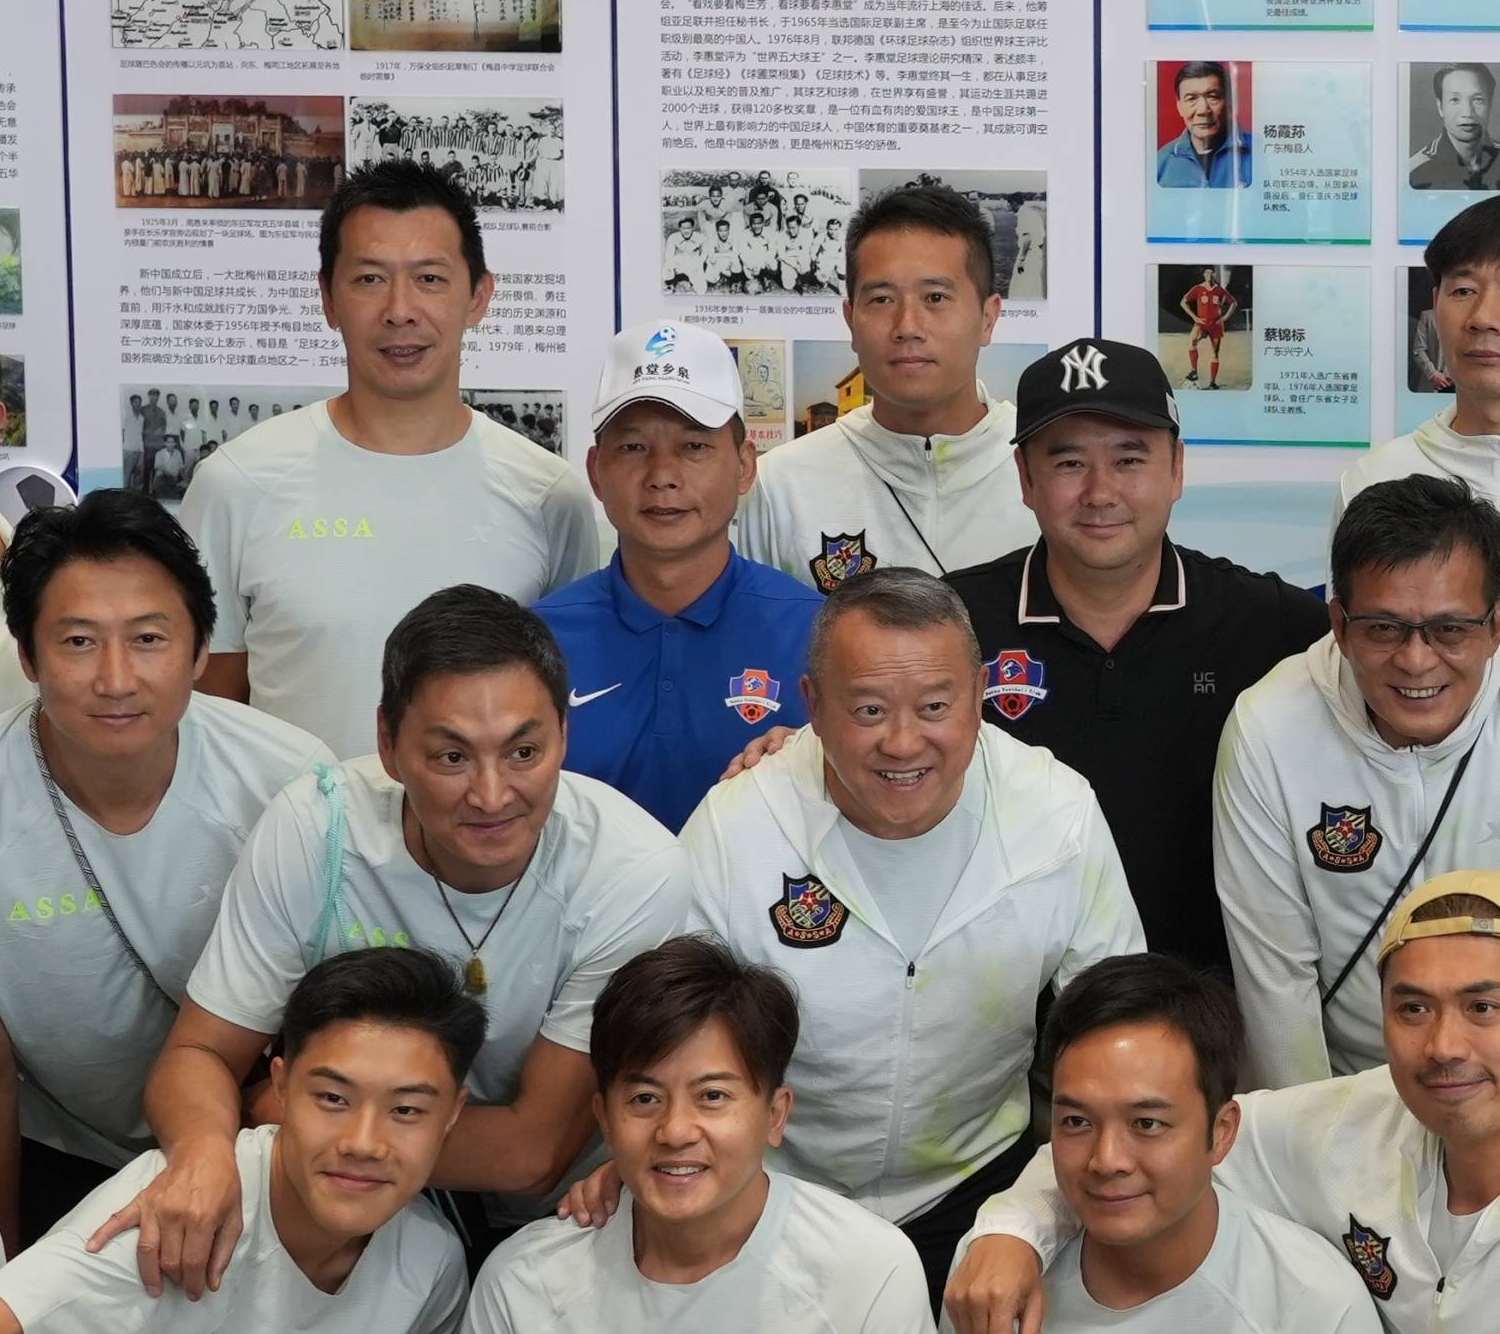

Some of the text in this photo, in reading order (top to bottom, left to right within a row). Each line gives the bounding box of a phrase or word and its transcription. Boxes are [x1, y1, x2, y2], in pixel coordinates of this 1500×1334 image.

[1263, 143, 1313, 153] 广东梅县人
[1264, 328, 1306, 342] 蔡锦标
[1264, 347, 1313, 357] 广东兴宁人
[1060, 344, 1109, 393] NY
[289, 518, 373, 539] ASSA
